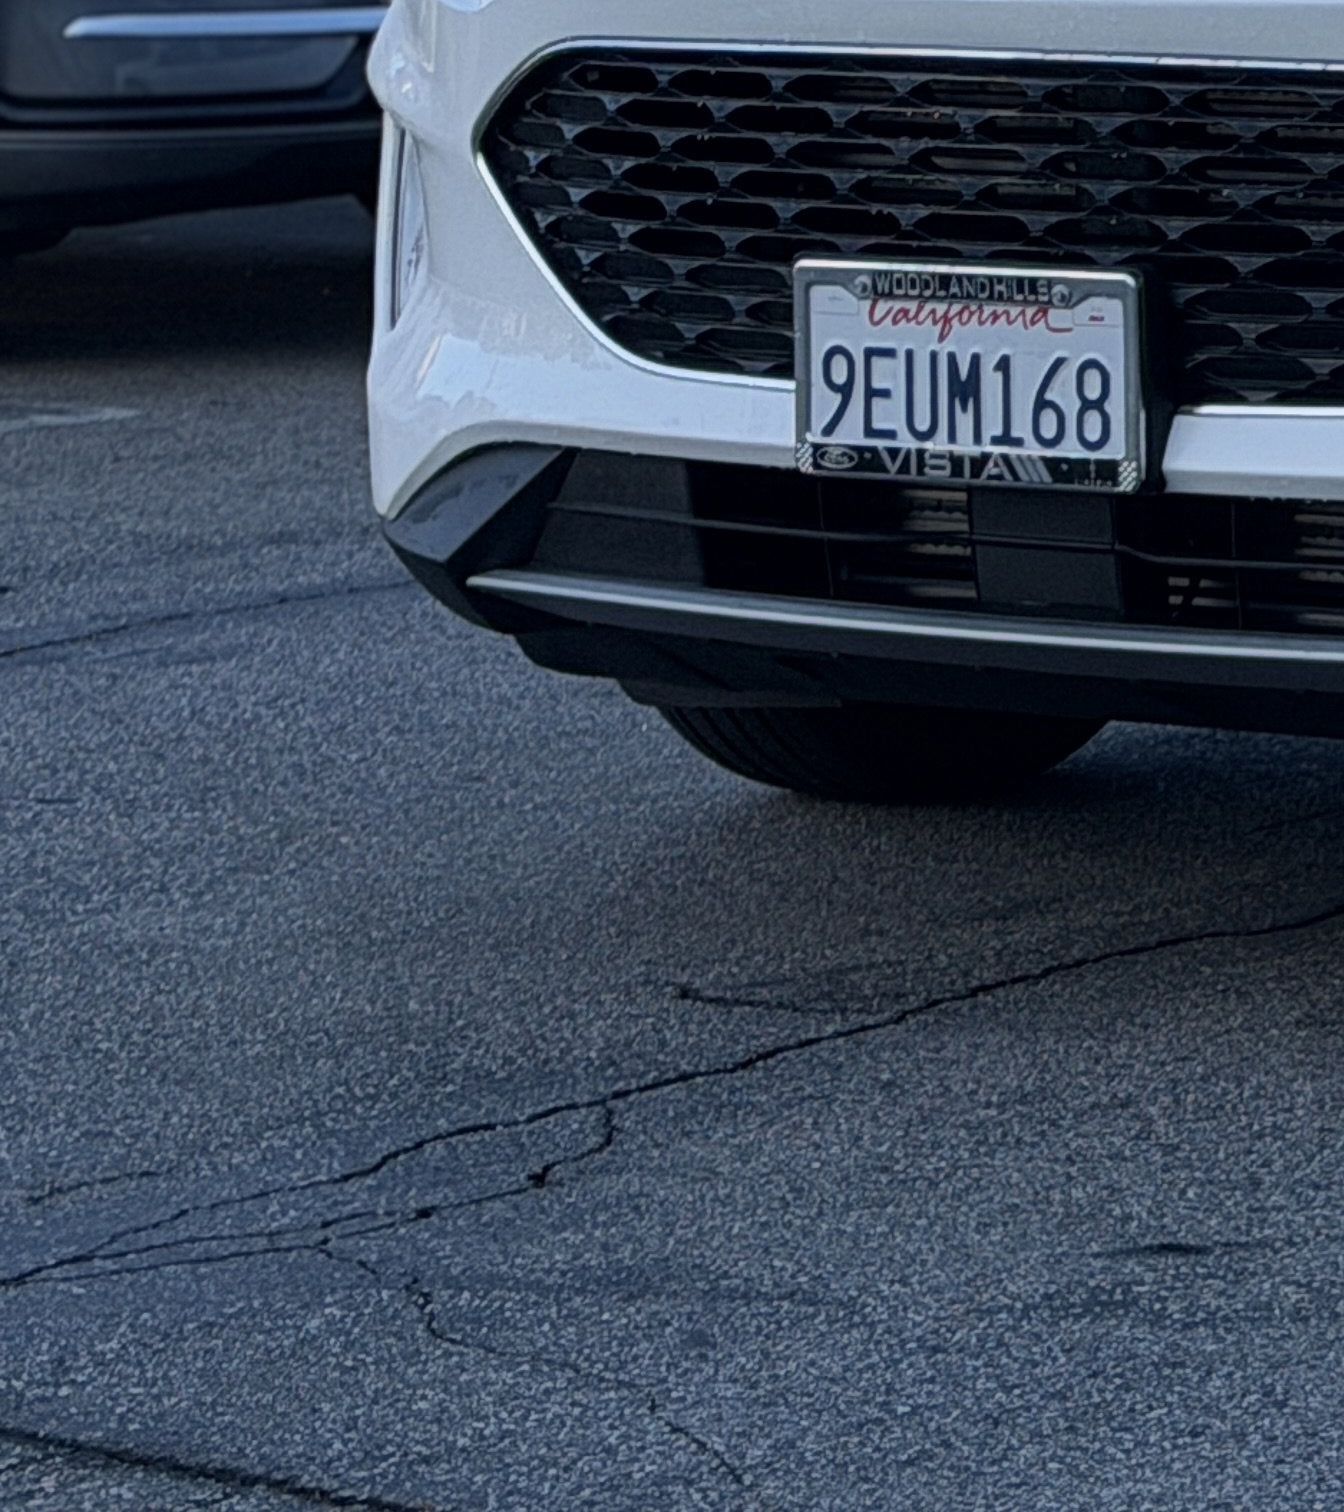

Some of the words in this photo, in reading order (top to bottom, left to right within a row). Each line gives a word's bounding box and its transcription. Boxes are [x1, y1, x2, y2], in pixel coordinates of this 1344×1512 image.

[873, 272, 991, 299] WOODLAND
[867, 297, 1074, 344] California
[820, 343, 1113, 453] 9EUM168
[877, 446, 1016, 482] VISTA
